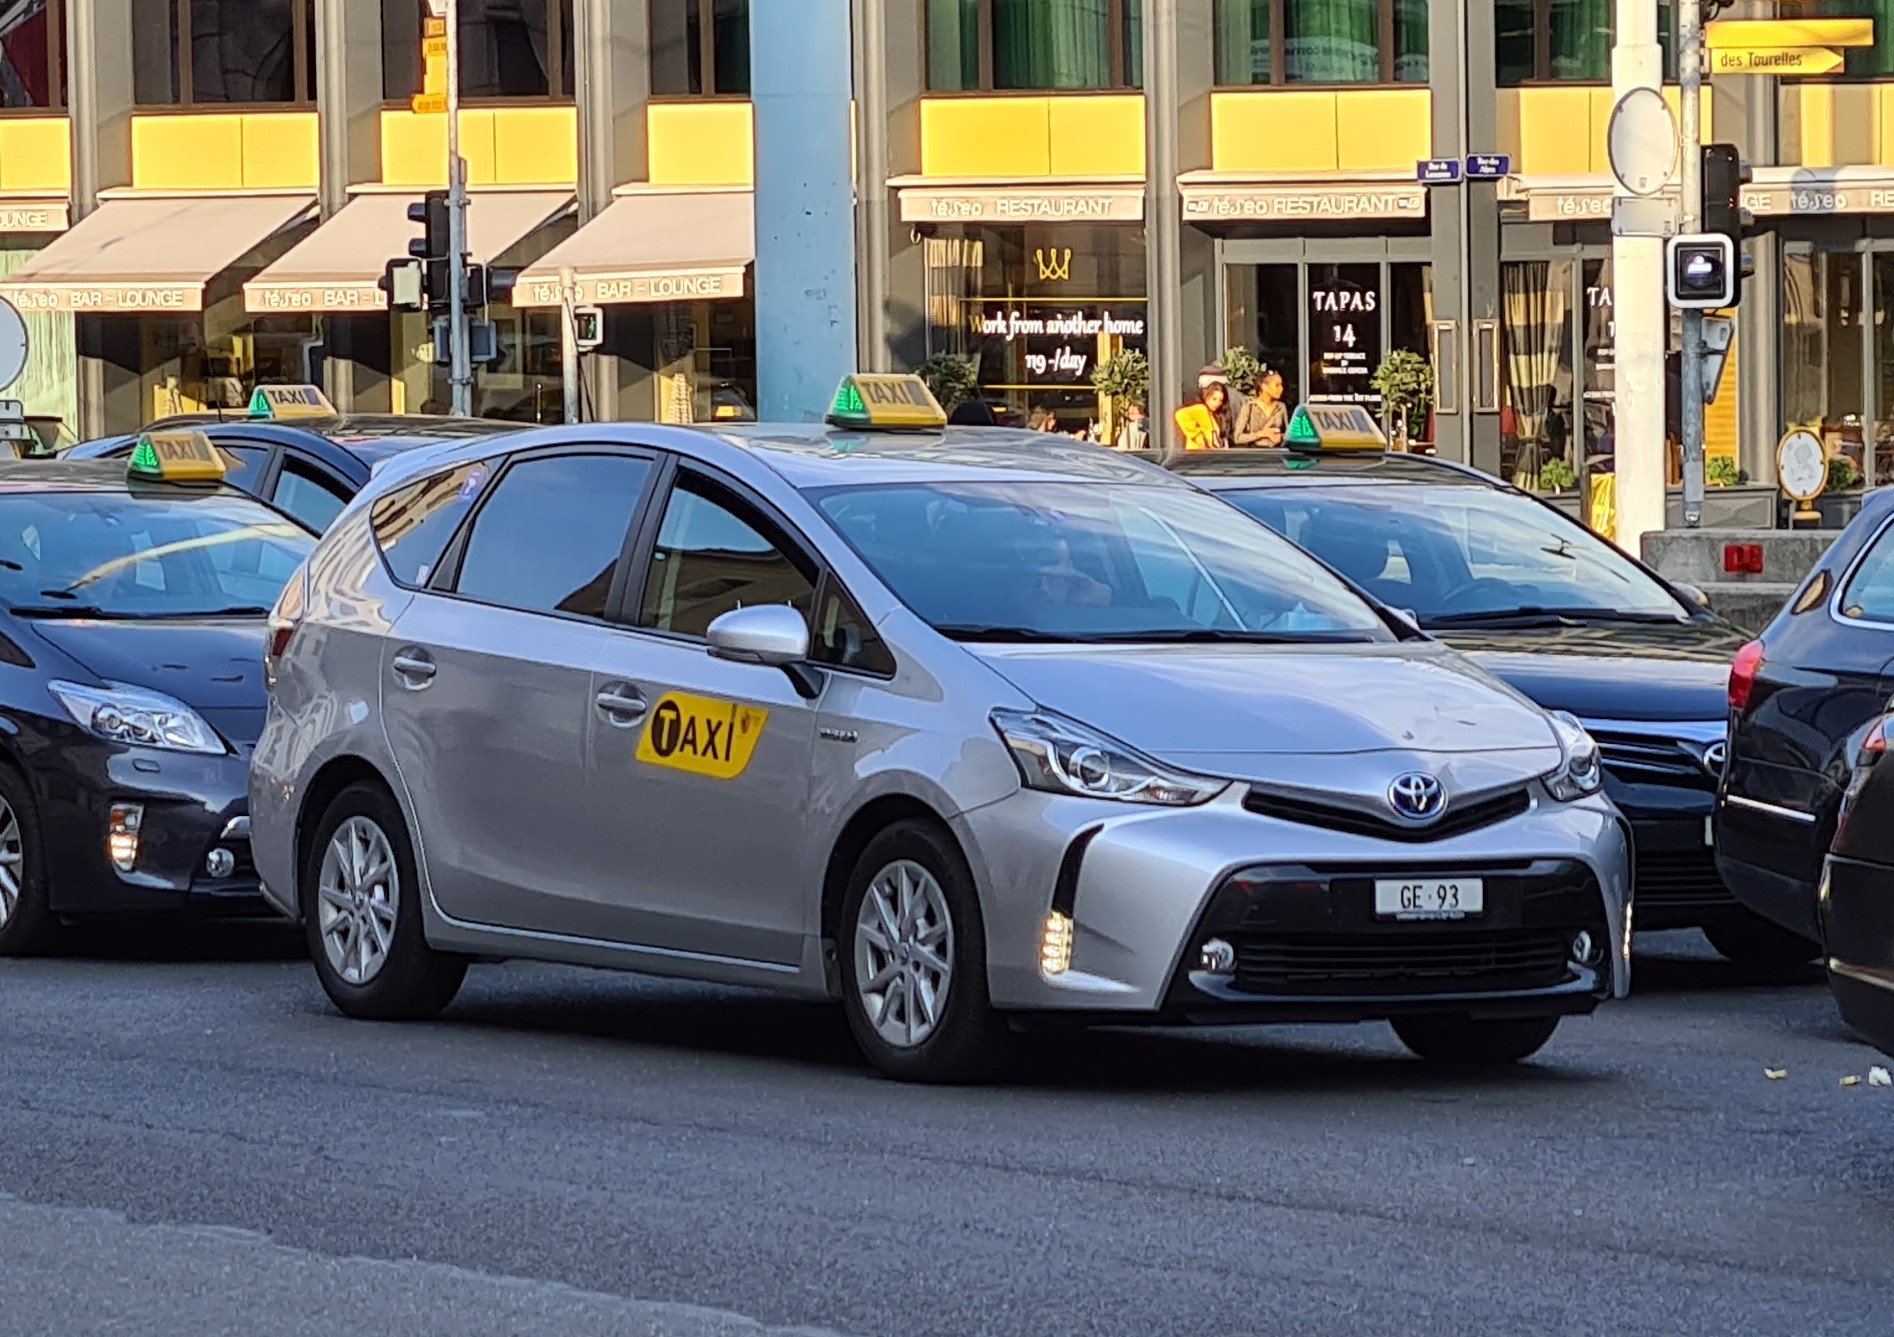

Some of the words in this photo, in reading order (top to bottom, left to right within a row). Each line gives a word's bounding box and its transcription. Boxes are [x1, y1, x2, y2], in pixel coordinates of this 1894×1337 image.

[1721, 53, 1742, 67] des
[1747, 51, 1803, 67] Tourelles
[996, 197, 1113, 217] RESTAURANT
[1272, 193, 1397, 214] RESTAURANT
[324, 289, 359, 306] BAR
[597, 281, 632, 298] BAR
[650, 276, 721, 297] LOUNGE
[71, 290, 103, 307] BAR
[118, 290, 184, 307] LOUNGE
[1313, 290, 1376, 311] TAPAS
[969, 311, 1008, 334] Work
[1006, 311, 1045, 341] from
[1047, 310, 1103, 334] another
[1103, 310, 1144, 334] home
[1333, 323, 1357, 348] 14
[268, 389, 307, 405] TAXI
[859, 380, 912, 404] TAXI
[1311, 411, 1356, 431] TAXI
[154, 439, 194, 460] TAXI
[652, 699, 738, 763] TAXI
[1400, 884, 1424, 909] GE
[1437, 884, 1459, 909] 93
